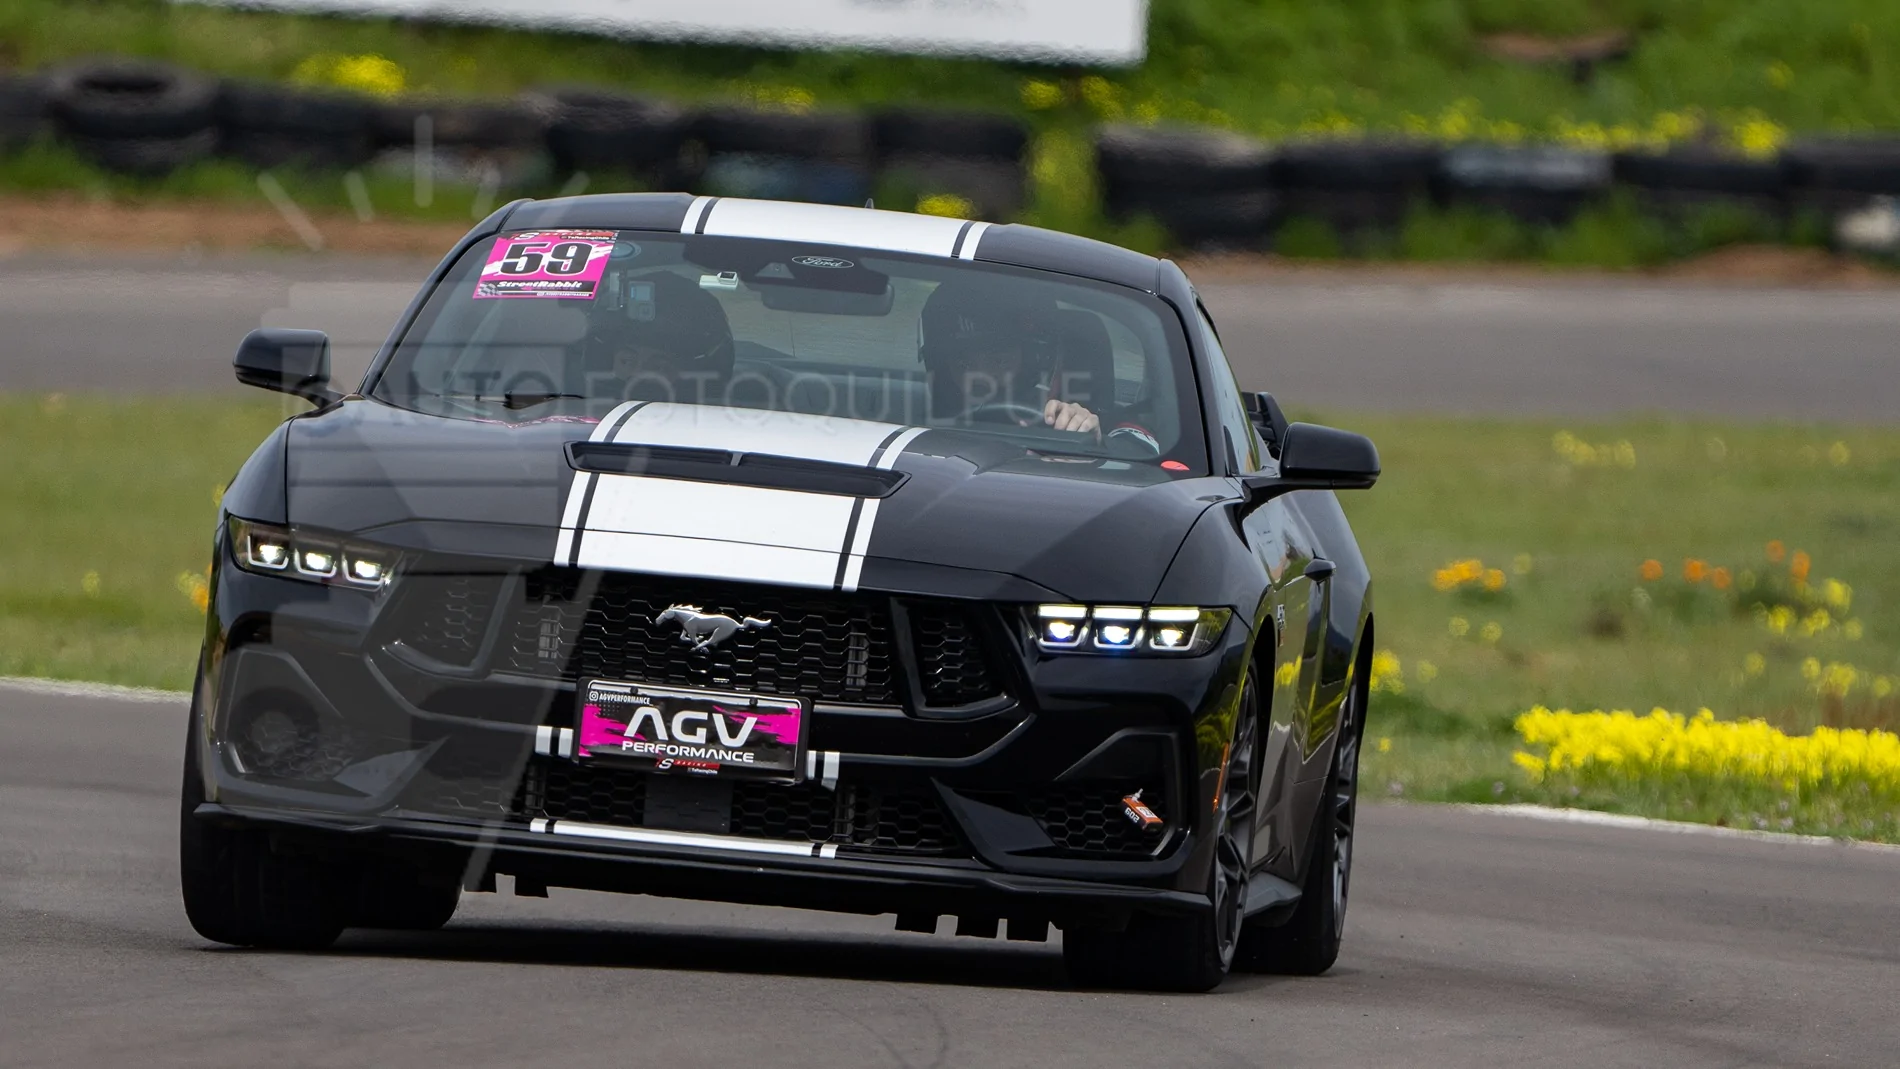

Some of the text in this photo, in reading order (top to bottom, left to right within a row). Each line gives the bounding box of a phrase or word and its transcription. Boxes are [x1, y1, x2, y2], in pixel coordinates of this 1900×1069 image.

[500, 241, 594, 277] 59
[802, 256, 843, 268] Ford
[497, 280, 583, 289] StreetRabbit
[623, 706, 758, 748] AGV
[621, 740, 755, 764] PERFORMANCE
